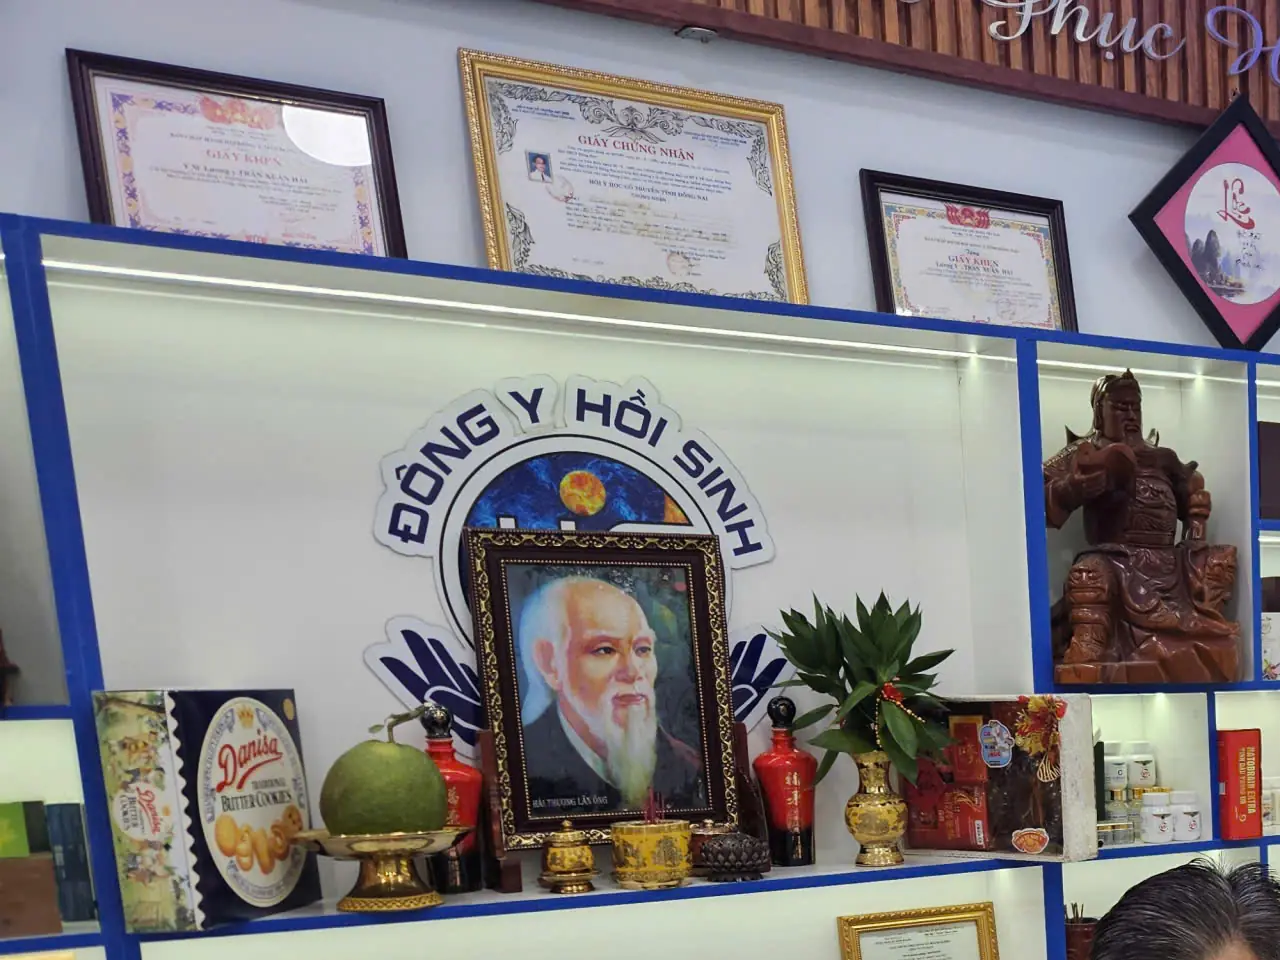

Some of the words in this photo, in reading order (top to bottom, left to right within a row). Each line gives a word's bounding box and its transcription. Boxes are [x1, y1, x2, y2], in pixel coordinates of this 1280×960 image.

[988, 0, 1186, 61] Phục
[578, 133, 610, 148] GIẤY
[613, 135, 657, 157] CHỨNG
[660, 149, 695, 161] NHẬN
[387, 403, 501, 545] ĐÔNG
[508, 387, 545, 424] Y
[575, 389, 669, 447] HỒI
[672, 439, 763, 557] SINH
[216, 729, 283, 793] Danisa
[221, 793, 257, 812] BUTTER
[257, 790, 293, 807] COOKIES
